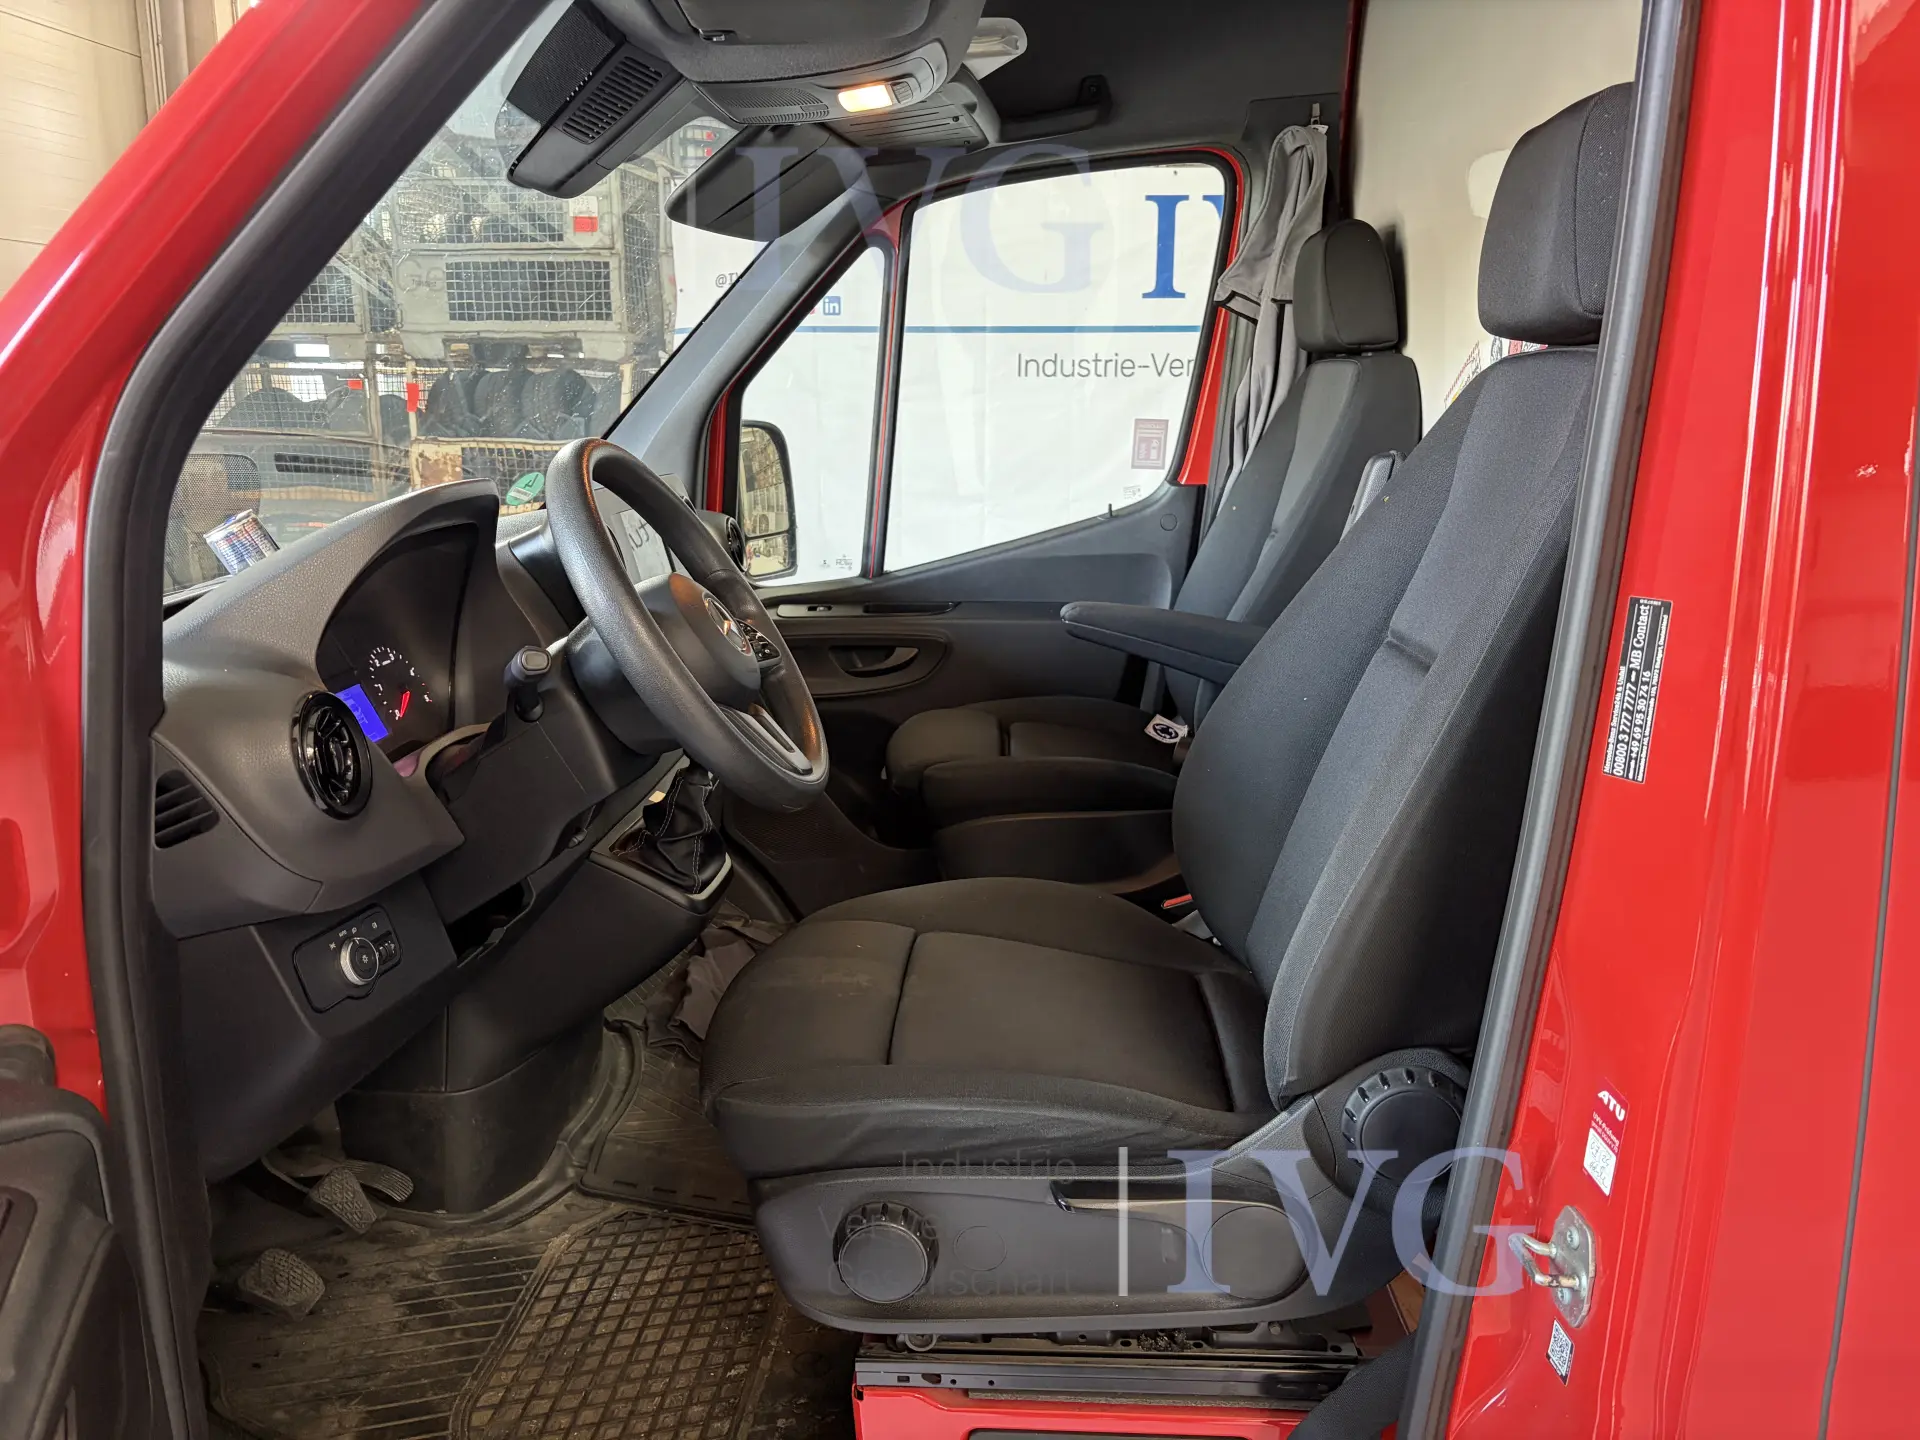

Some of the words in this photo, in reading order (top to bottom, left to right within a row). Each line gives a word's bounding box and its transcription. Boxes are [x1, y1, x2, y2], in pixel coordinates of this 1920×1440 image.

[715, 272, 740, 288] @I
[1632, 603, 1649, 648] Contact
[1628, 648, 1642, 669] MB
[1641, 669, 1651, 682] 16
[1622, 682, 1637, 711] 7777
[1639, 684, 1648, 697] 74
[1636, 698, 1646, 711] 30
[1619, 711, 1632, 733] 777
[1634, 712, 1644, 725] 95
[1617, 732, 1629, 742] 3
[1632, 726, 1642, 739] 69
[1629, 740, 1640, 758] +49
[1612, 742, 1627, 776] 00800
[1597, 1090, 1626, 1122] ATU
